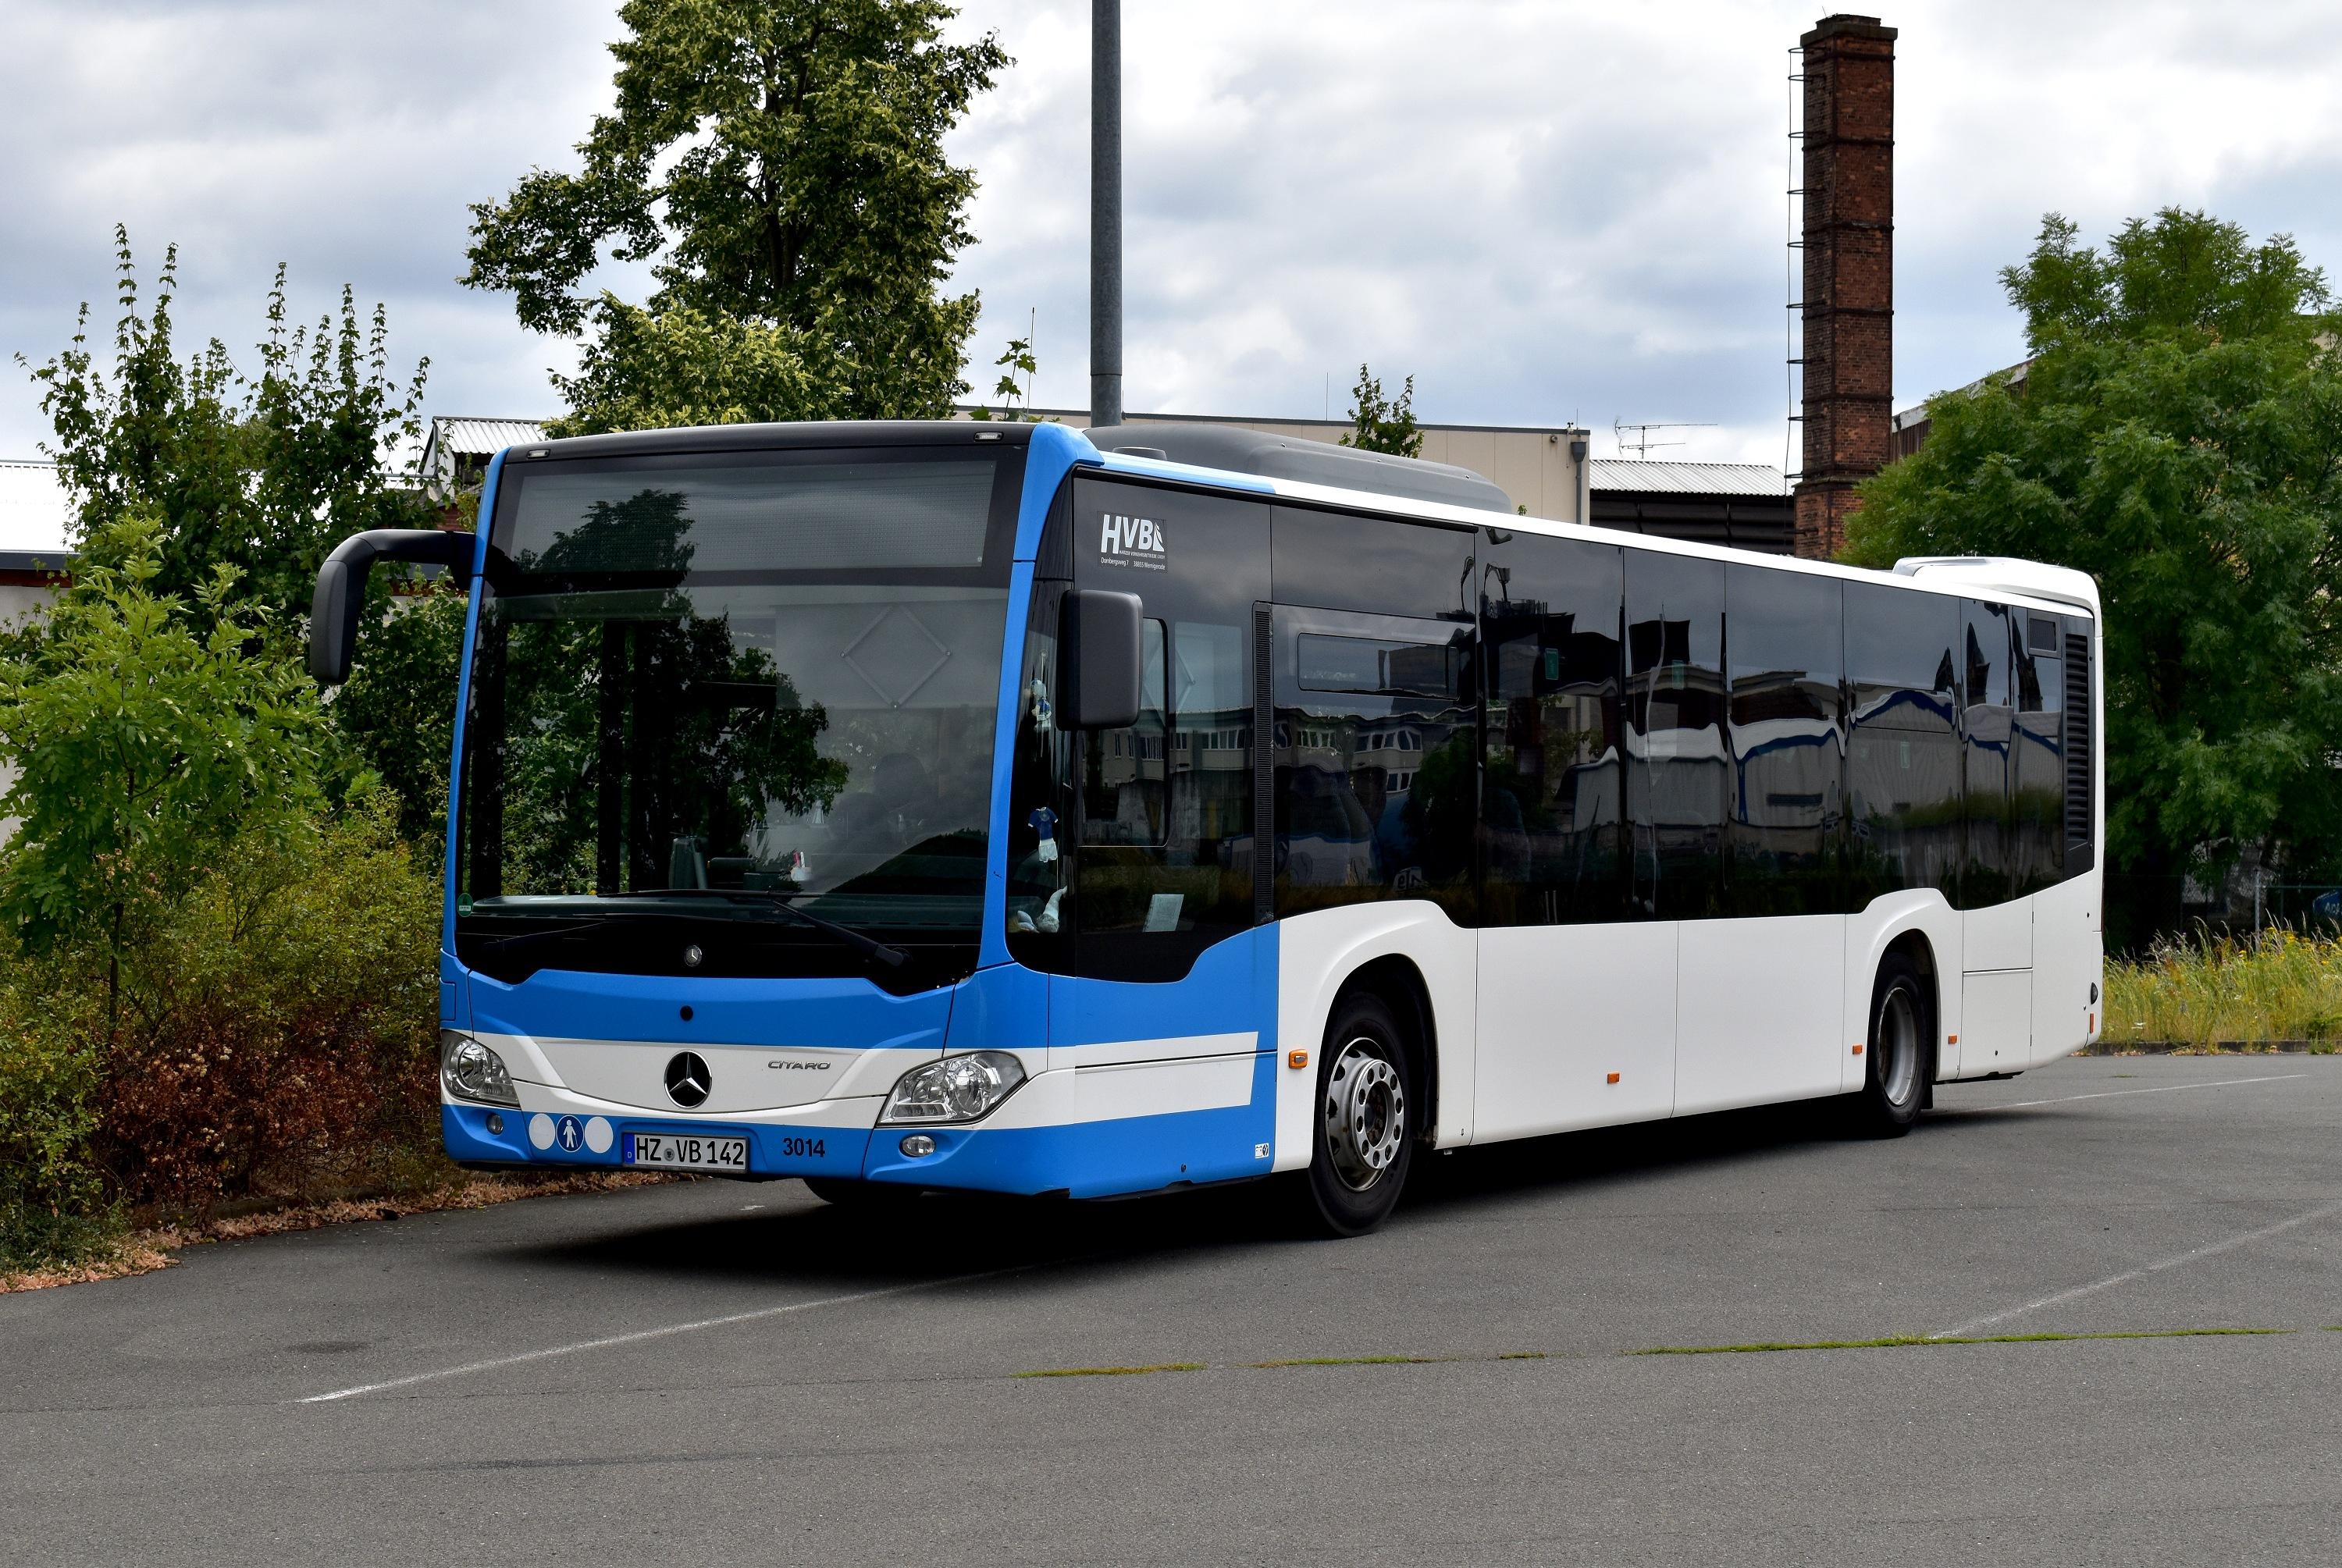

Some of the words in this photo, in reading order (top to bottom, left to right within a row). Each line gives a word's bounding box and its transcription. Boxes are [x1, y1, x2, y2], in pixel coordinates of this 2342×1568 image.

[1101, 514, 1154, 554] HVB
[767, 1060, 831, 1070] CITARO
[636, 1137, 661, 1161] HZ
[676, 1140, 702, 1163] VB
[707, 1141, 744, 1165] 142
[782, 1137, 826, 1157] 3014
